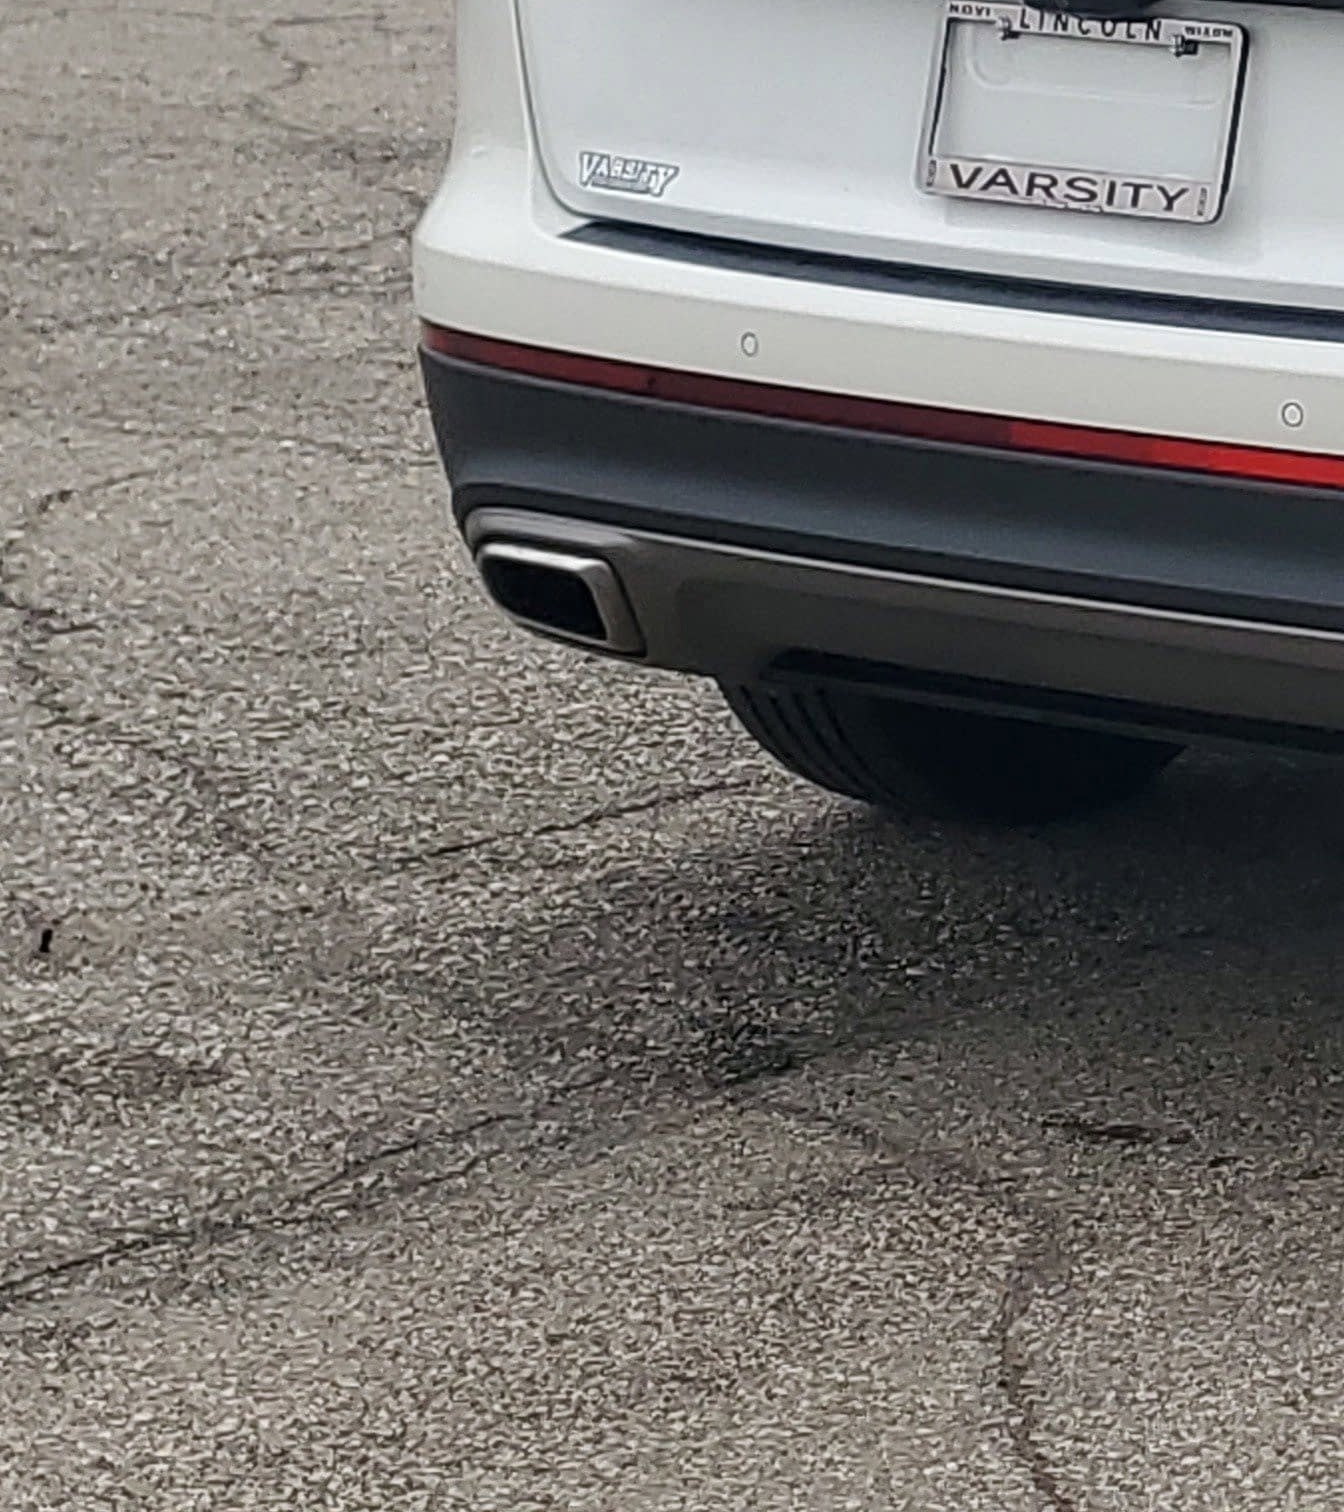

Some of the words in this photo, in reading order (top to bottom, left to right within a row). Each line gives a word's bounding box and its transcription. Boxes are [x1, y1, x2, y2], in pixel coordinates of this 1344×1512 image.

[949, 3, 991, 17] NOVI
[1019, 8, 1162, 41] LINCOLN
[579, 151, 679, 197] VARSITY
[949, 163, 1190, 212] VARSITY
